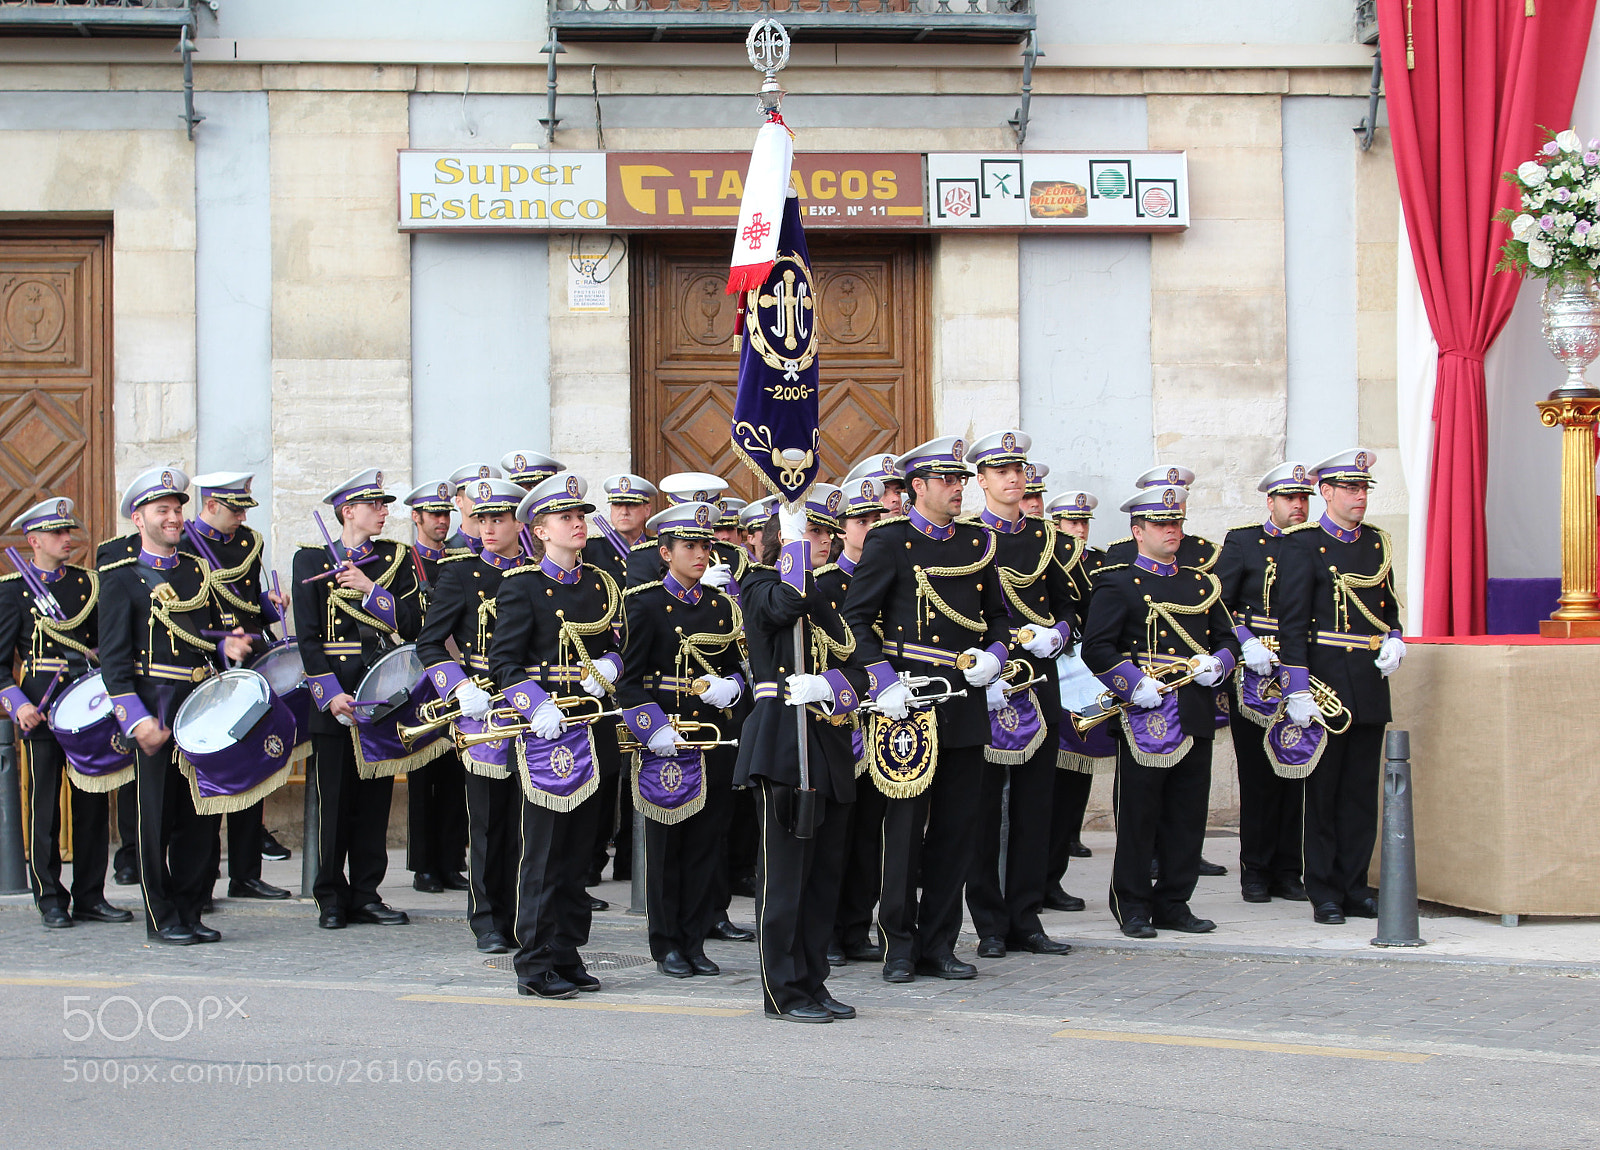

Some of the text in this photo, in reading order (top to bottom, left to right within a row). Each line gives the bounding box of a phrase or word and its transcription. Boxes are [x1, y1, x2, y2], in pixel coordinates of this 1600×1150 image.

[434, 157, 582, 192] Super
[1045, 186, 1077, 197] EURO
[409, 192, 606, 220] Estanco
[1030, 194, 1087, 206] MILLONES
[809, 205, 841, 216] EXP.
[870, 205, 886, 216] 11
